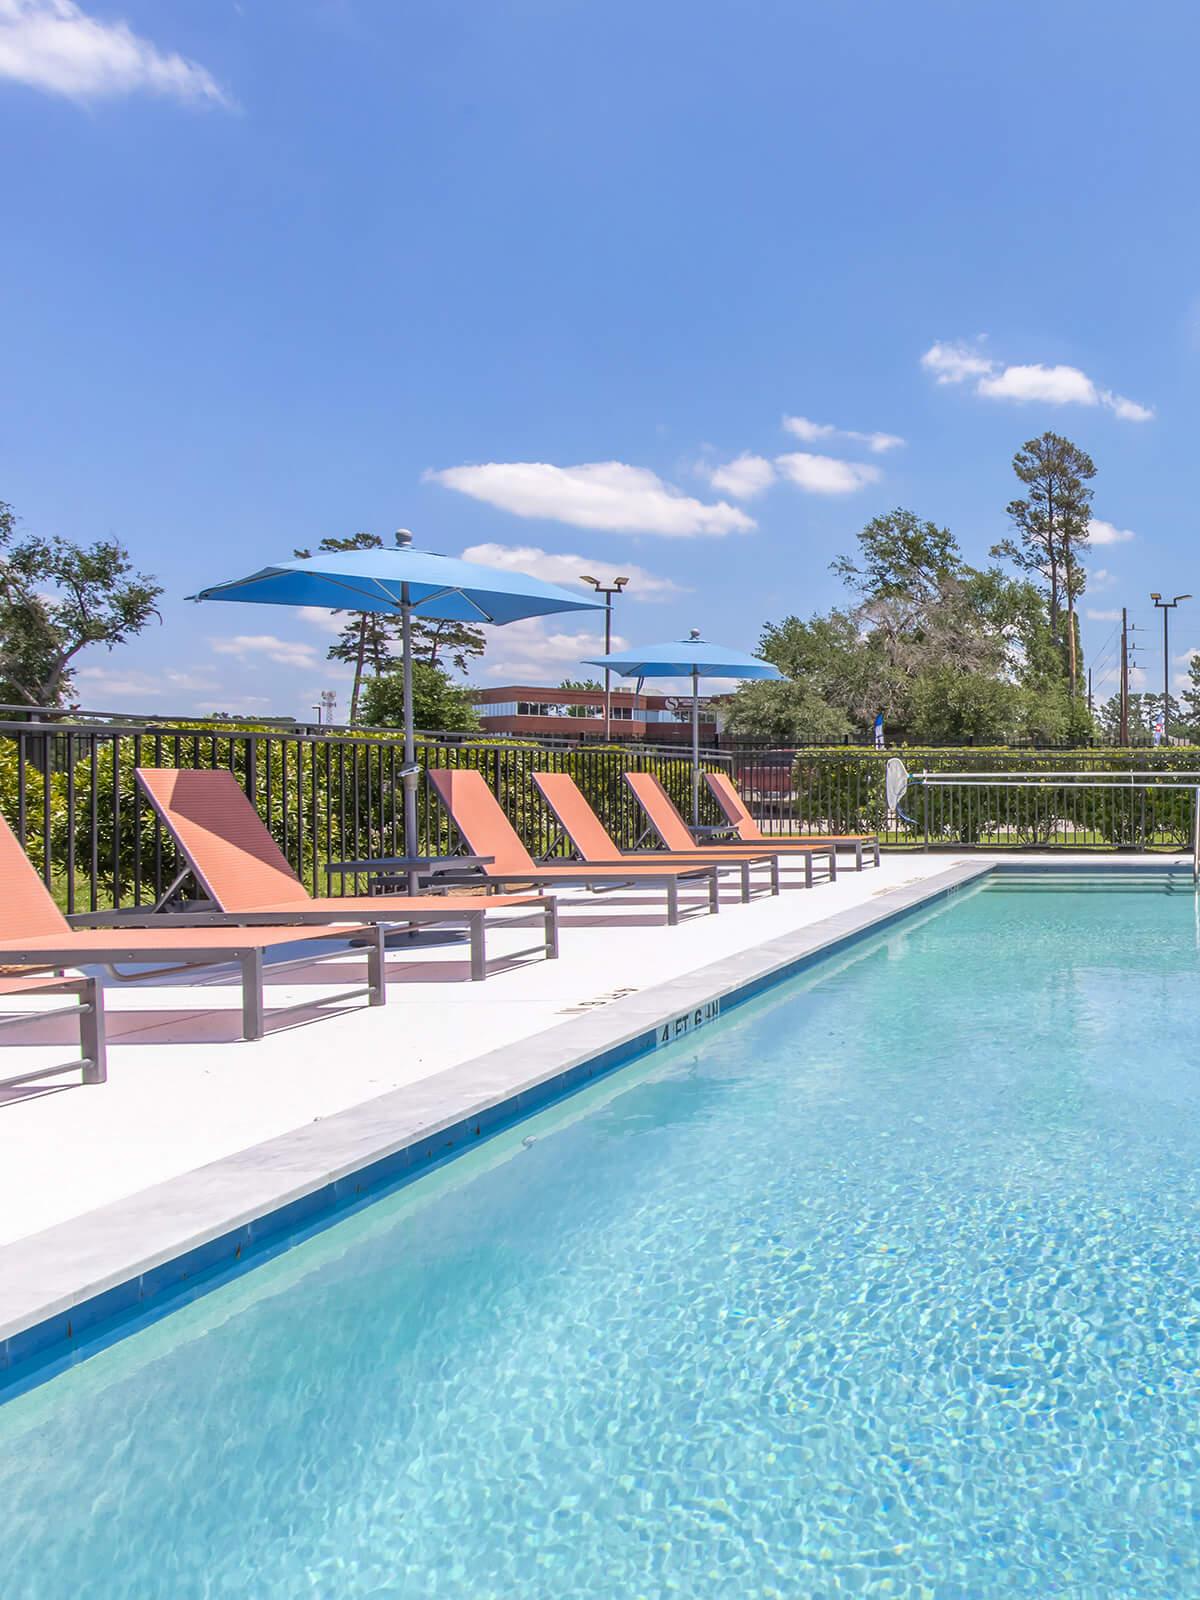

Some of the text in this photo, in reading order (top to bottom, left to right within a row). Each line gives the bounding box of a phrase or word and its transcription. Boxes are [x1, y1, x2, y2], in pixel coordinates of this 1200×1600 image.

[661, 1024, 669, 1041] 4
[675, 1014, 688, 1035] FT
[705, 999, 719, 1018] IN
